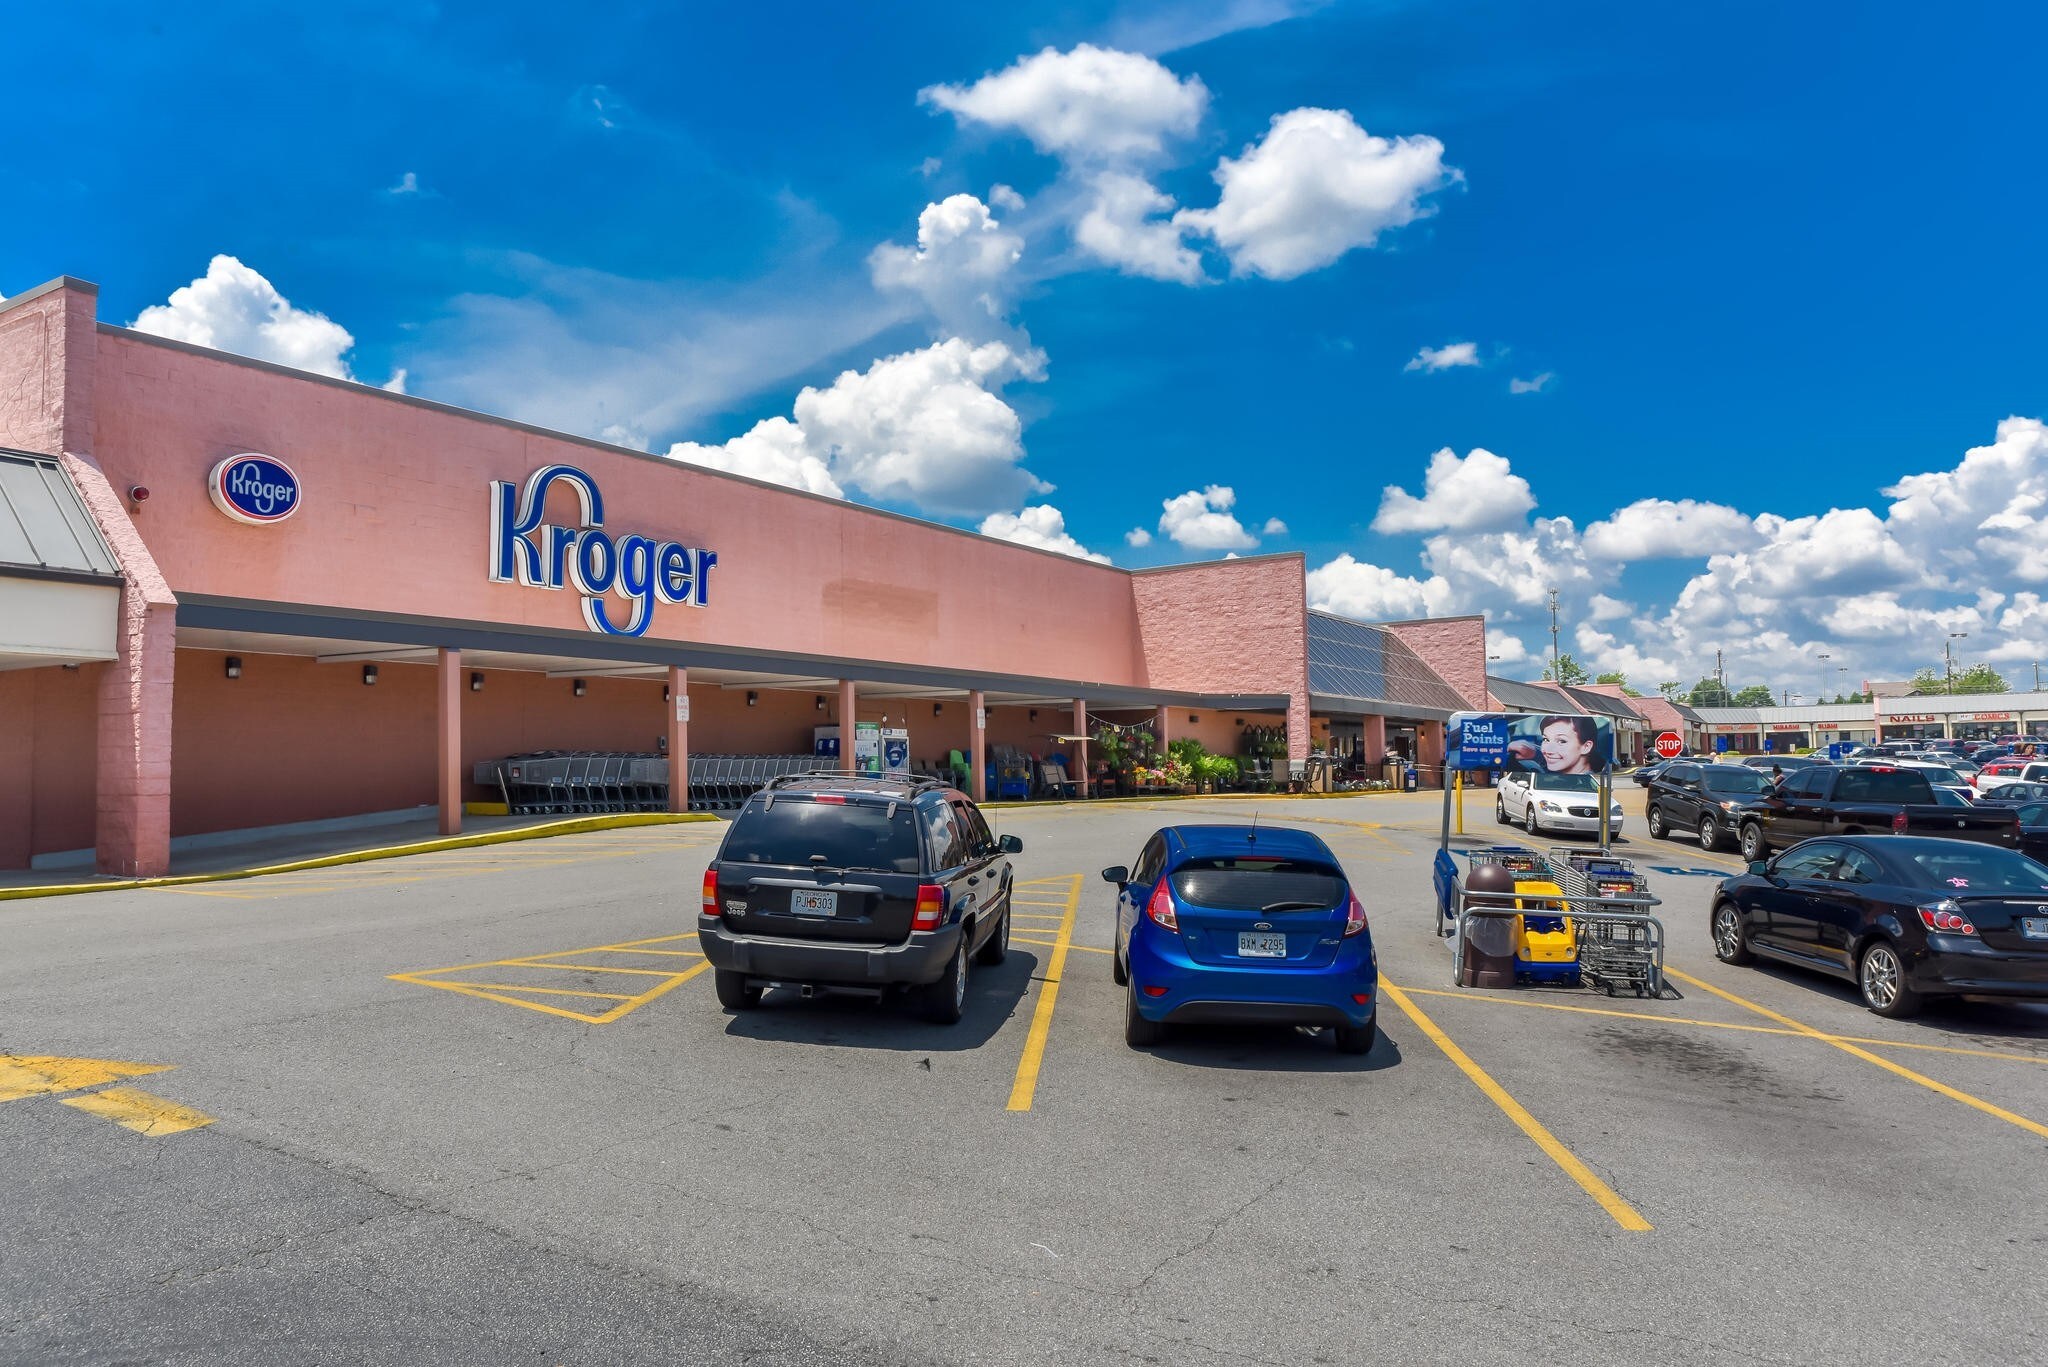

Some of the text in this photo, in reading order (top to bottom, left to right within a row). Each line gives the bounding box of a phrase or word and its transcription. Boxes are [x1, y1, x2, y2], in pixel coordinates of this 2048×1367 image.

[231, 463, 293, 513] Kroger
[490, 464, 718, 638] Kroger
[1889, 714, 1935, 722] NAILS
[1974, 712, 2010, 720] COMICS
[1463, 722, 1493, 733] Fuel
[1462, 733, 1504, 744] Points
[1657, 740, 1680, 750] STOP
[727, 907, 746, 917] Jeep
